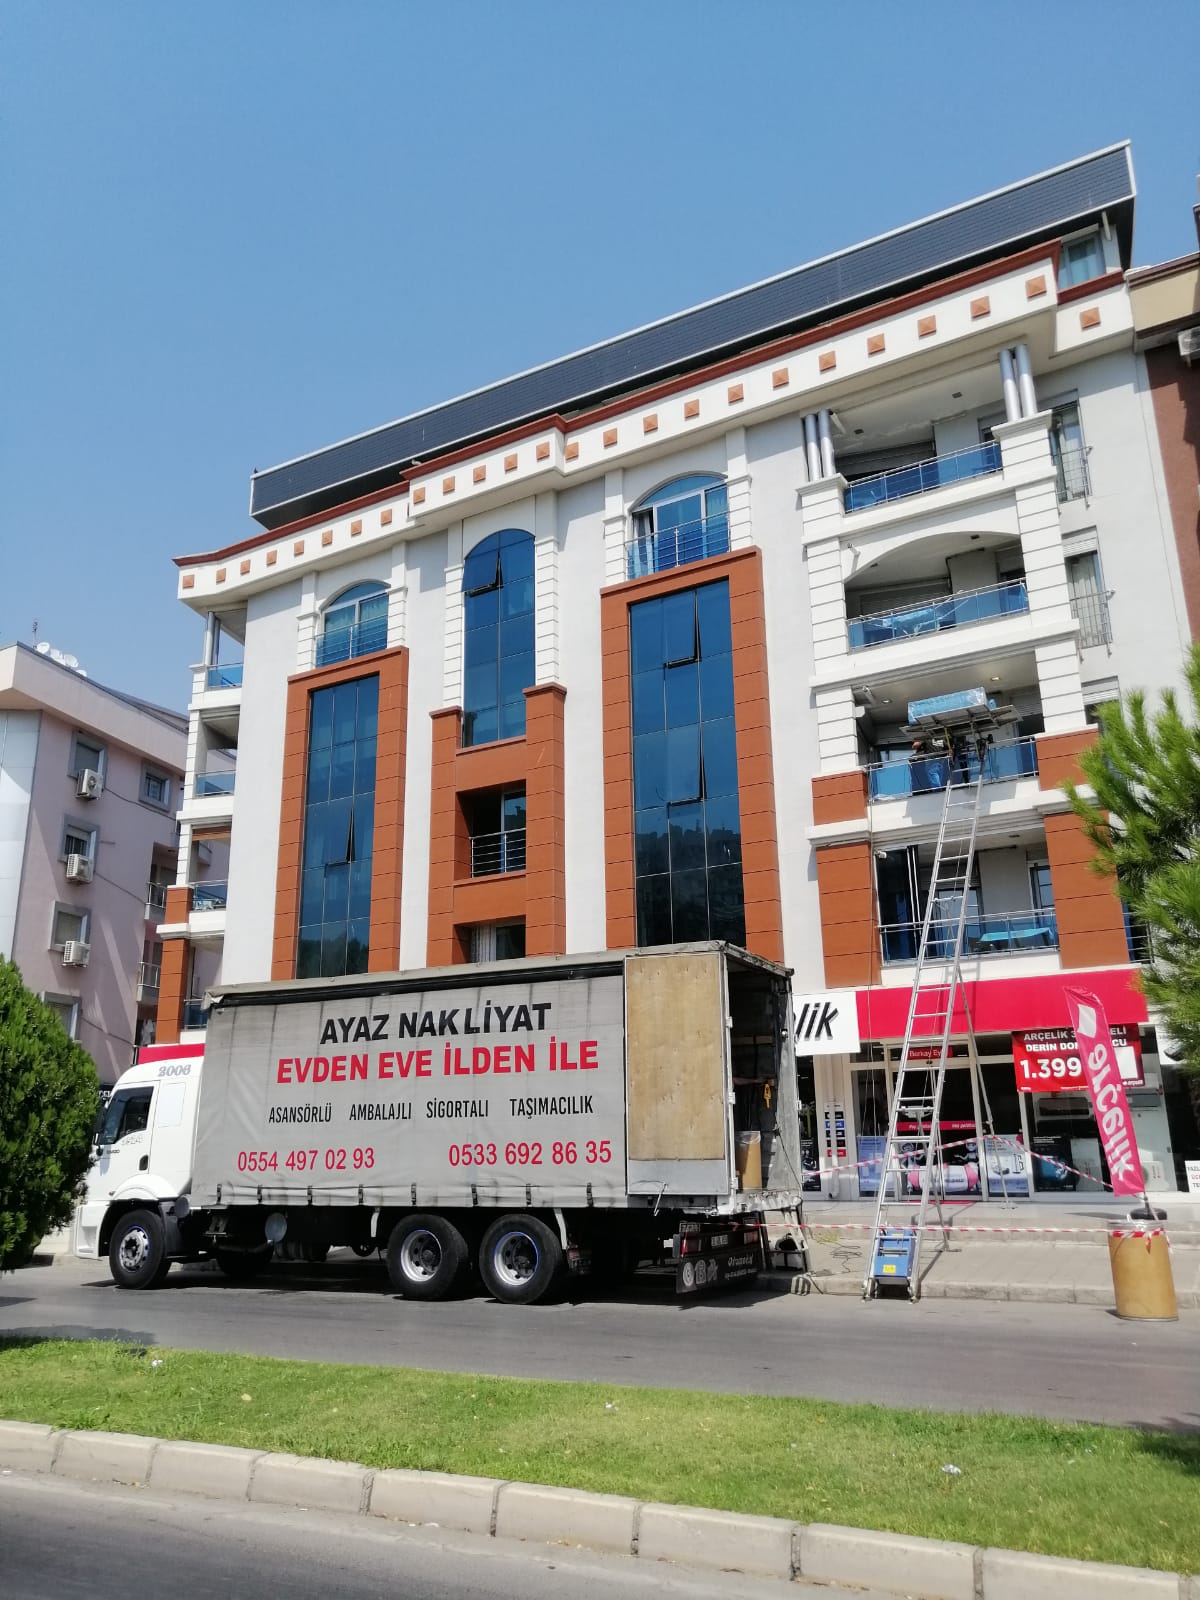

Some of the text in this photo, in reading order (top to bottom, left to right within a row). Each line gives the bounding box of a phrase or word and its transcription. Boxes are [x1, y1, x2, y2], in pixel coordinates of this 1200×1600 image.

[320, 1000, 551, 1044] AYAZ NAKLİYAT
[794, 1002, 838, 1039] lik
[1024, 1030, 1068, 1041] ARÇELİK
[1111, 1026, 1127, 1036] ELİ
[1026, 1041, 1057, 1052] DERİN
[1113, 1038, 1127, 1047] CU
[277, 1036, 598, 1083] EVDEN EVE İLDEN İLE
[1019, 1056, 1082, 1079] 1.399
[269, 1095, 594, 1123] ASANSÖRLÜ AMBALAJLI SİGORTALI TAŞIMACILIK
[237, 1147, 375, 1171] 0554 497 02 93
[448, 1140, 612, 1166] 0533 692 86 35
